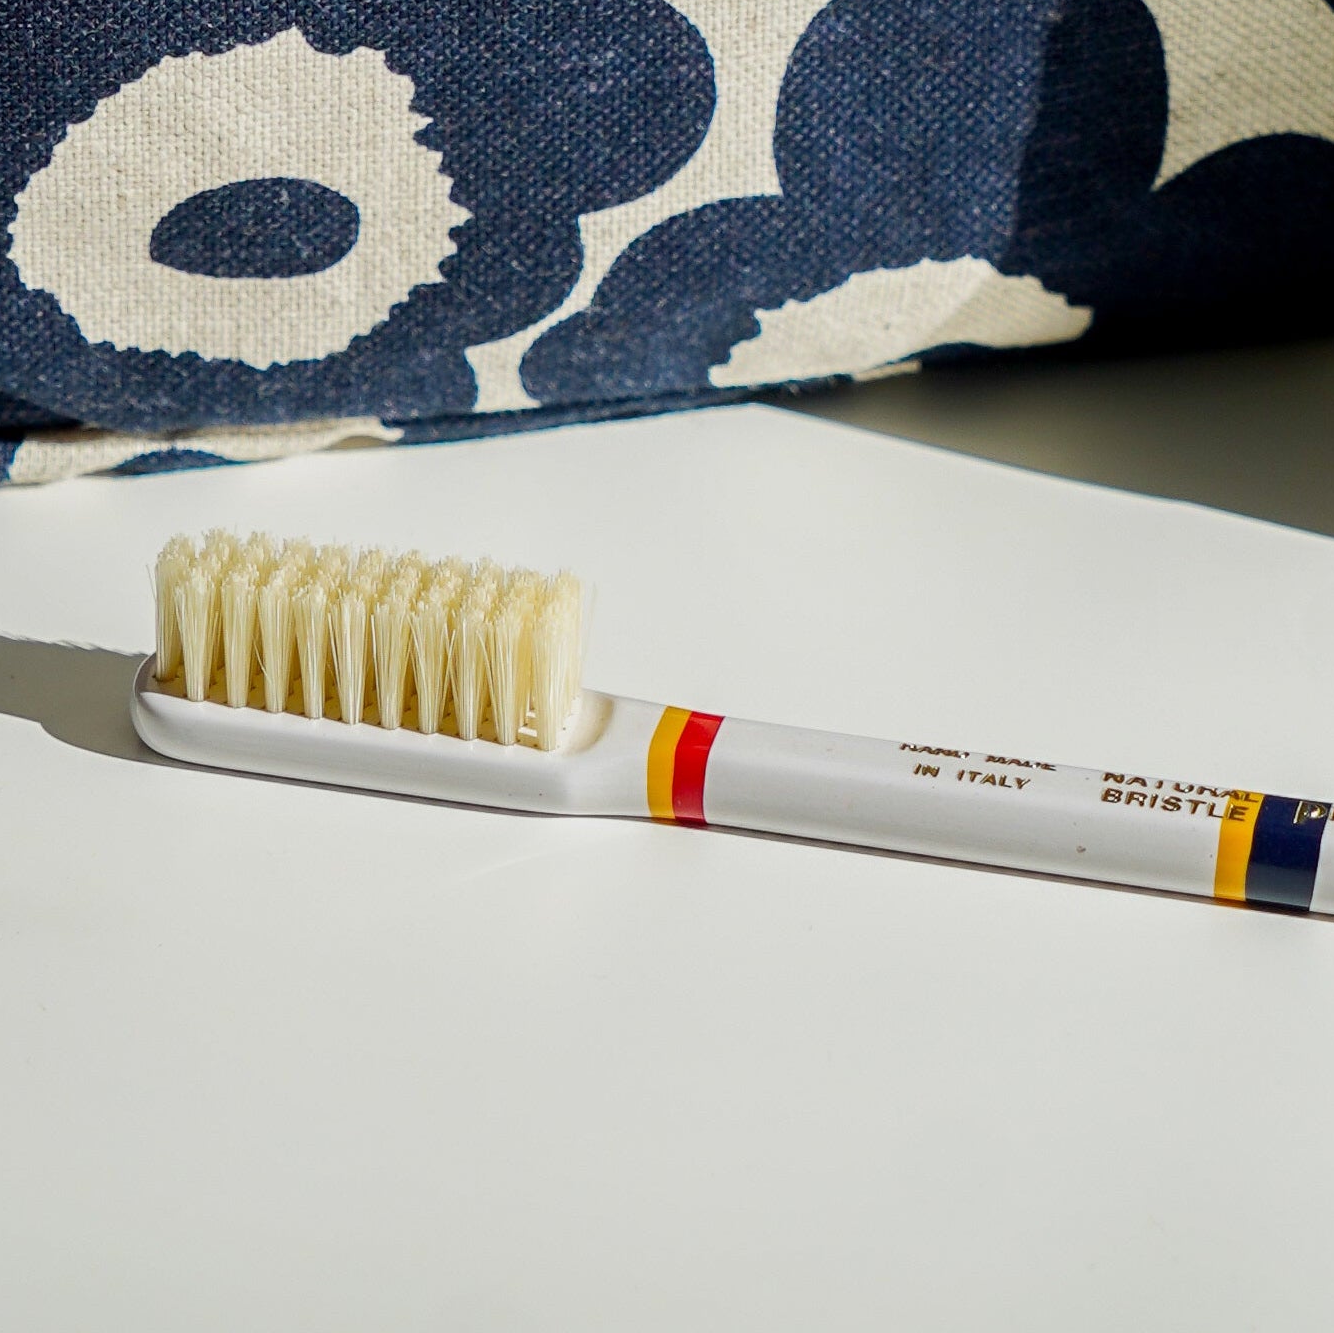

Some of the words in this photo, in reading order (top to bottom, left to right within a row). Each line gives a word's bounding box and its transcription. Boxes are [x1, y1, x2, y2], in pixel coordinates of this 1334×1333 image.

[912, 763, 941, 778] IN
[957, 769, 1031, 790] ITALY
[1101, 787, 1250, 822] BRISTLE
